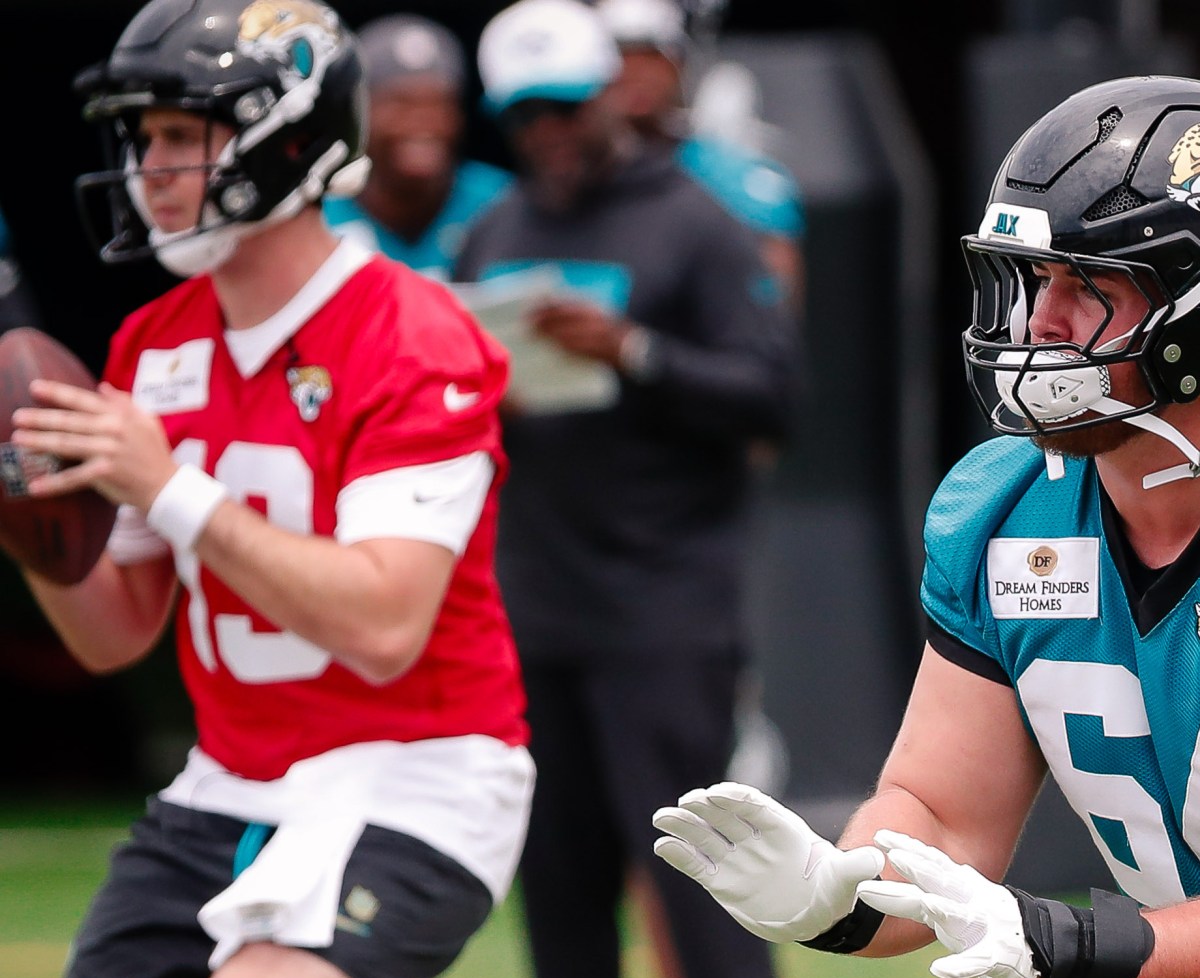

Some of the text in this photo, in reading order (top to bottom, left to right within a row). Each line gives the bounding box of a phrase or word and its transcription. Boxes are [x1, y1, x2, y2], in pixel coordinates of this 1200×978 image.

[1033, 555, 1052, 568] DF
[995, 581, 1090, 596] DREAM FINDERS
[1020, 597, 1062, 611] HOMES
